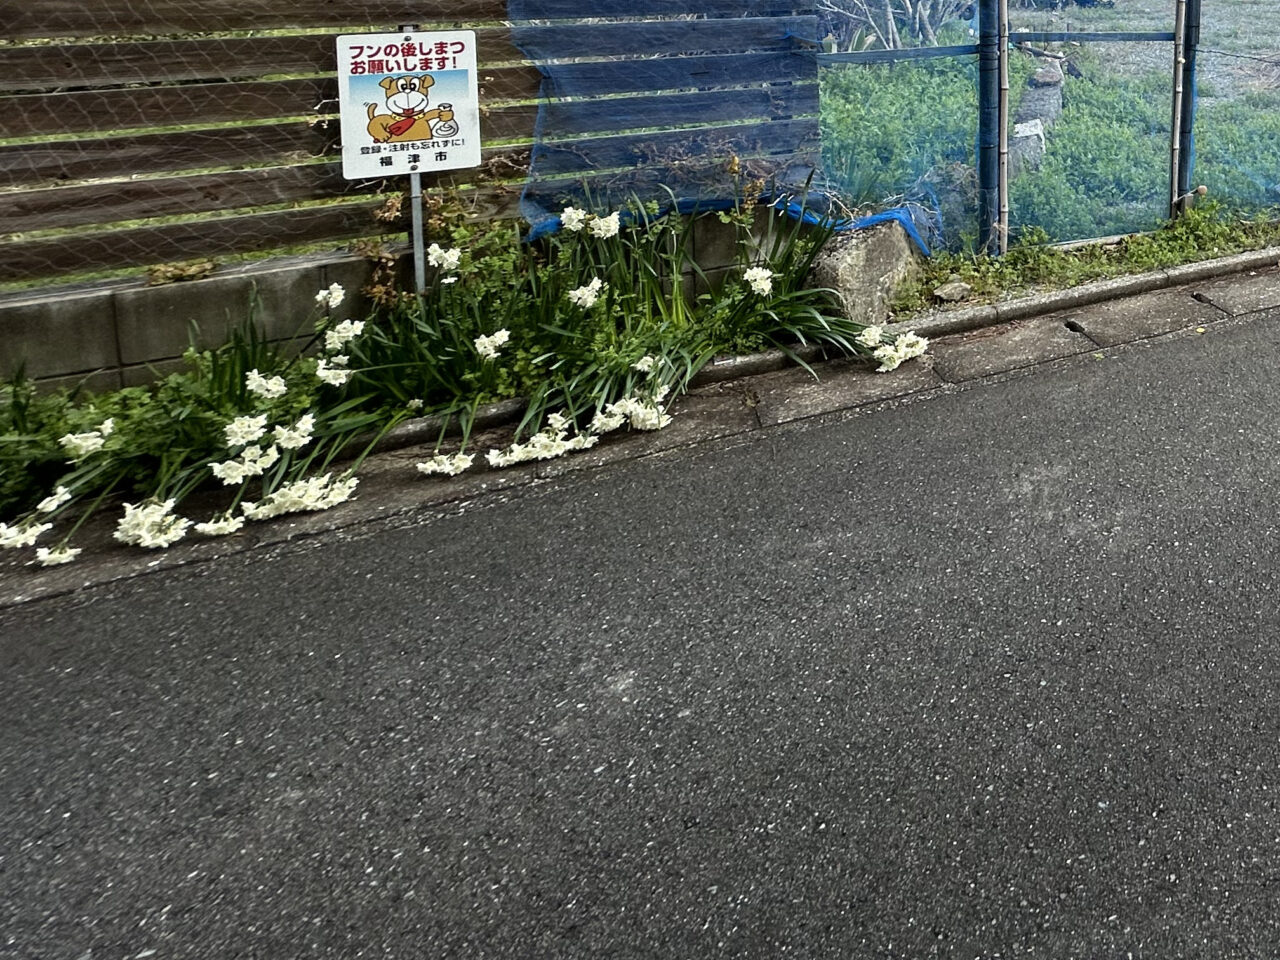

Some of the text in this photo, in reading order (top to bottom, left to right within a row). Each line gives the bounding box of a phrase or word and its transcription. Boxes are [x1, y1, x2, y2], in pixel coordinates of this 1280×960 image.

[349, 41, 465, 59] フンの後しまつ
[350, 56, 457, 75] お願いします!
